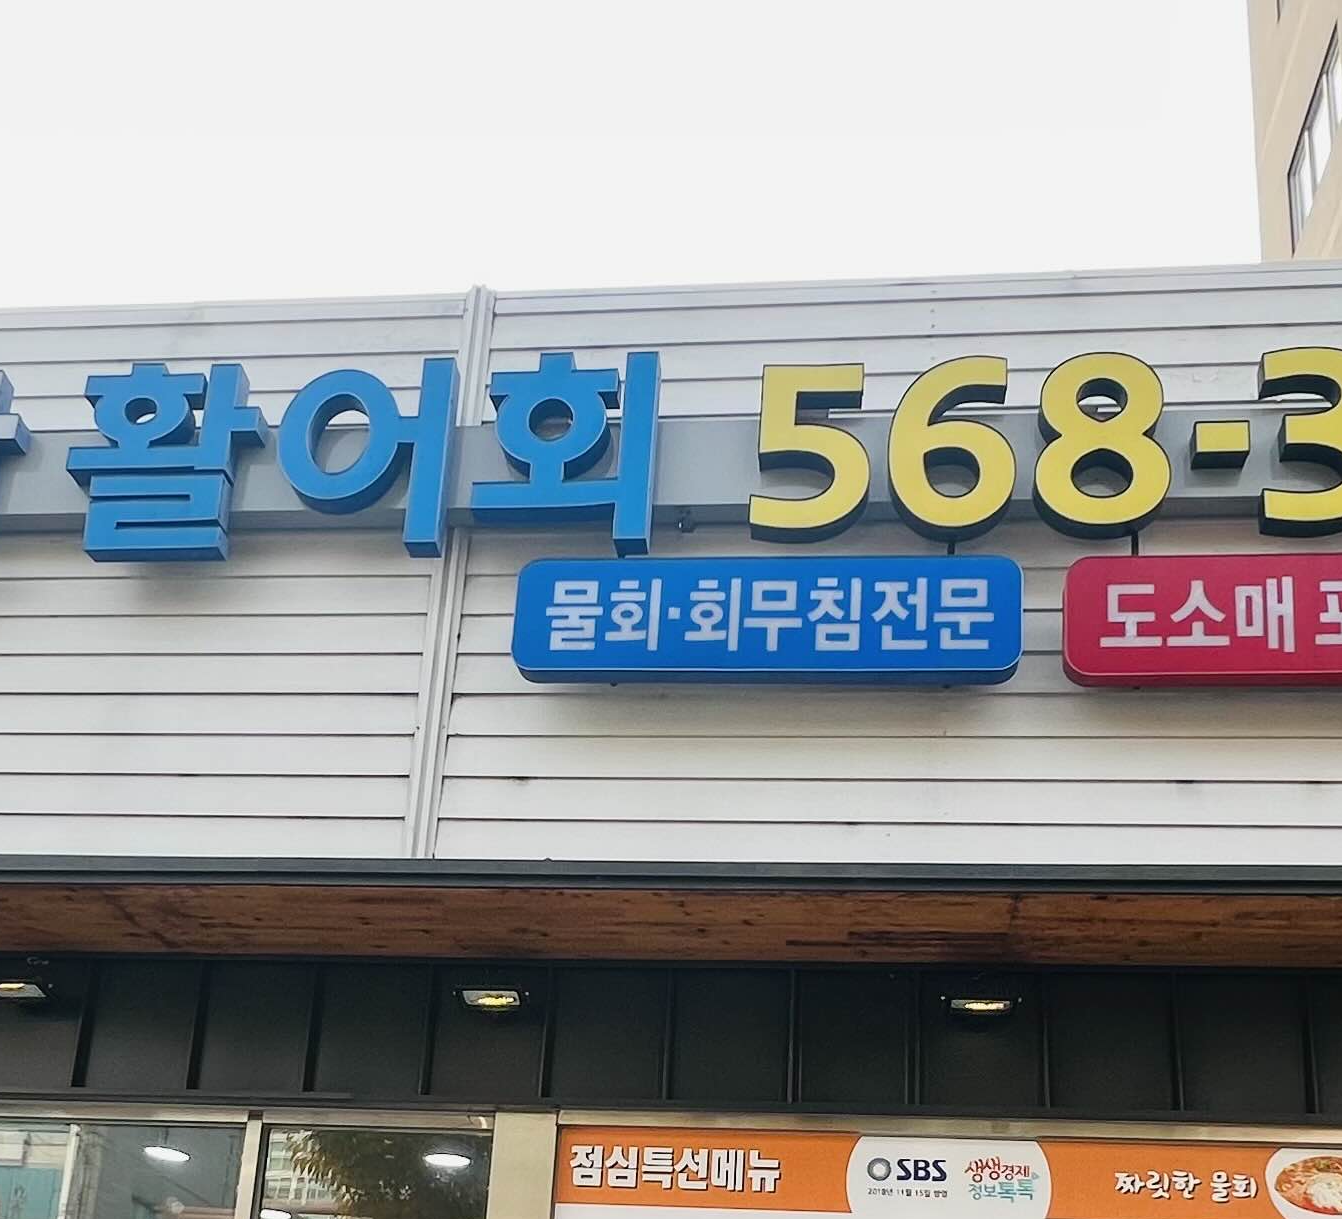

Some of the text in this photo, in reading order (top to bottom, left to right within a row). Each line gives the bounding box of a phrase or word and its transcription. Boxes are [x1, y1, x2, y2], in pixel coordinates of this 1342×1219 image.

[66, 350, 662, 560] 활어회
[544, 570, 998, 656] 물회·회무침전문
[1098, 578, 1298, 655] 도소매
[569, 1143, 782, 1194] 점심특선메뉴
[896, 1158, 947, 1182] SBS
[964, 1156, 1031, 1183] 생생경제
[1114, 1169, 1259, 1203] 짜릿한 물회
[968, 1178, 1035, 1203] 정보톡톡
